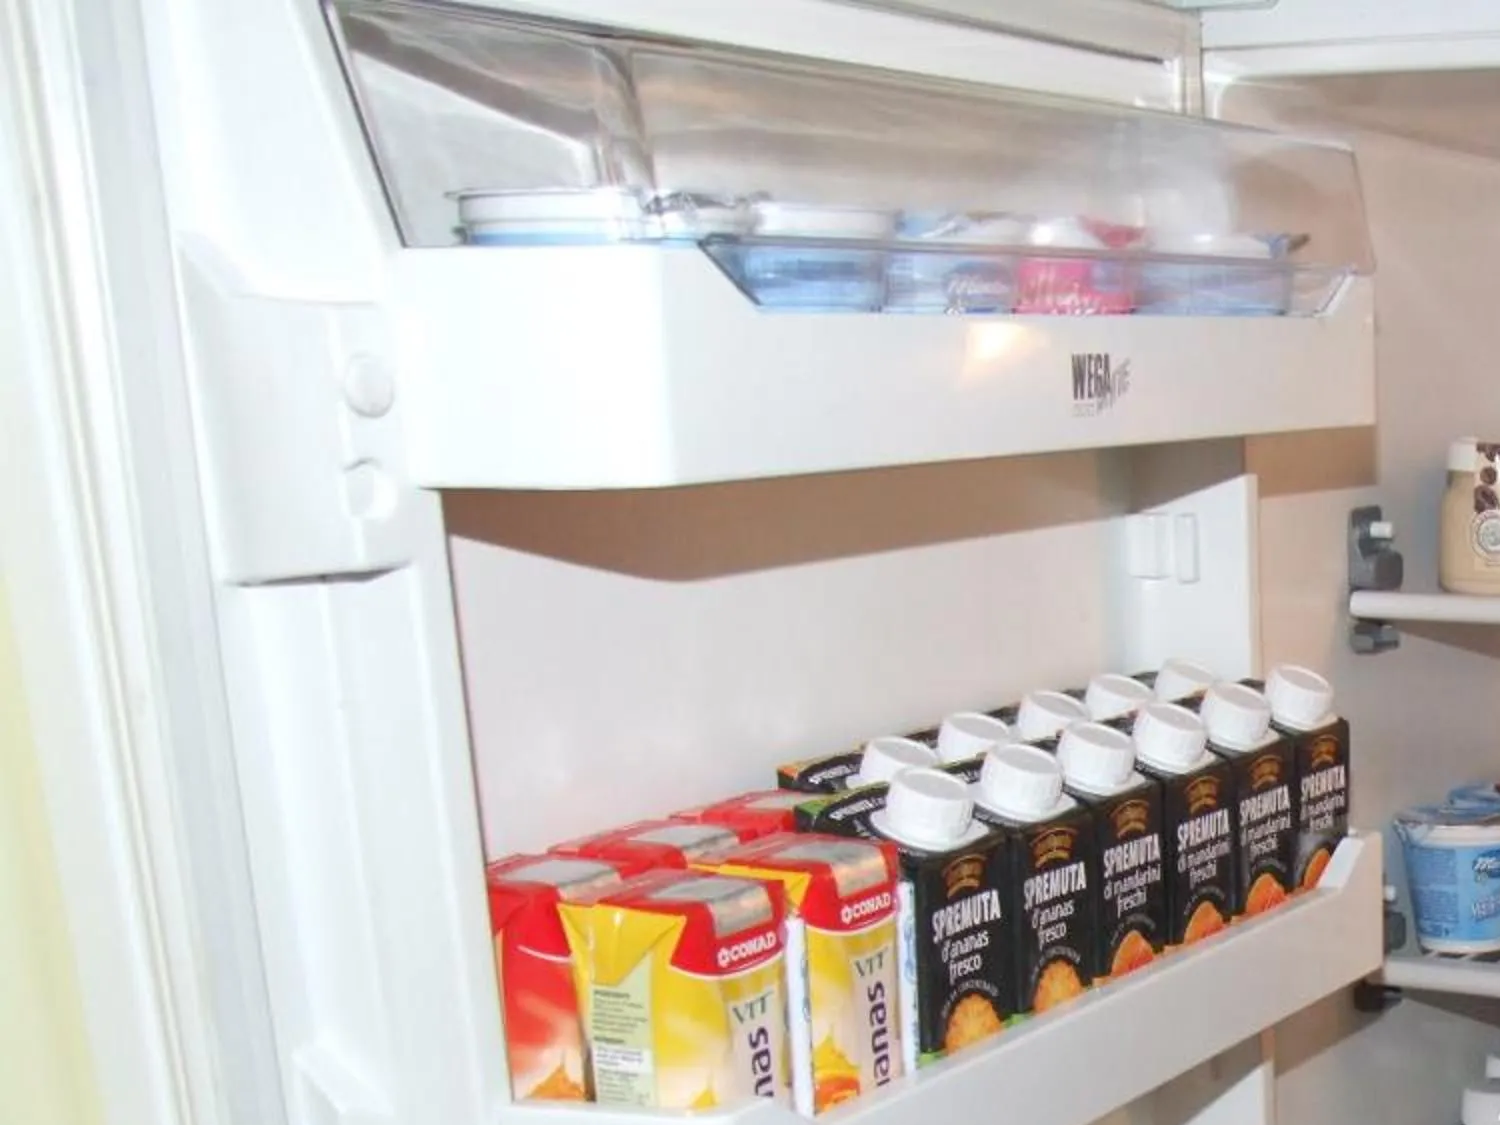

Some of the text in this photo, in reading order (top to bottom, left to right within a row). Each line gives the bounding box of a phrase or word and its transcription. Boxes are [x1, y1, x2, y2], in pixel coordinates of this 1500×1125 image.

[1072, 353, 1110, 400] WEGA
[1301, 765, 1345, 802] SPREMUTA
[1240, 784, 1291, 827] SPREMUTA
[1177, 808, 1230, 852] SPREMUTA
[1103, 833, 1160, 879] SPREMUTA
[852, 894, 892, 919] CONAD
[1024, 861, 1087, 911] SPREMUTA
[932, 889, 1001, 944] SPREMUTA
[1038, 922, 1067, 951] fresco
[732, 932, 777, 962] CONAD
[949, 954, 982, 985] fresco
